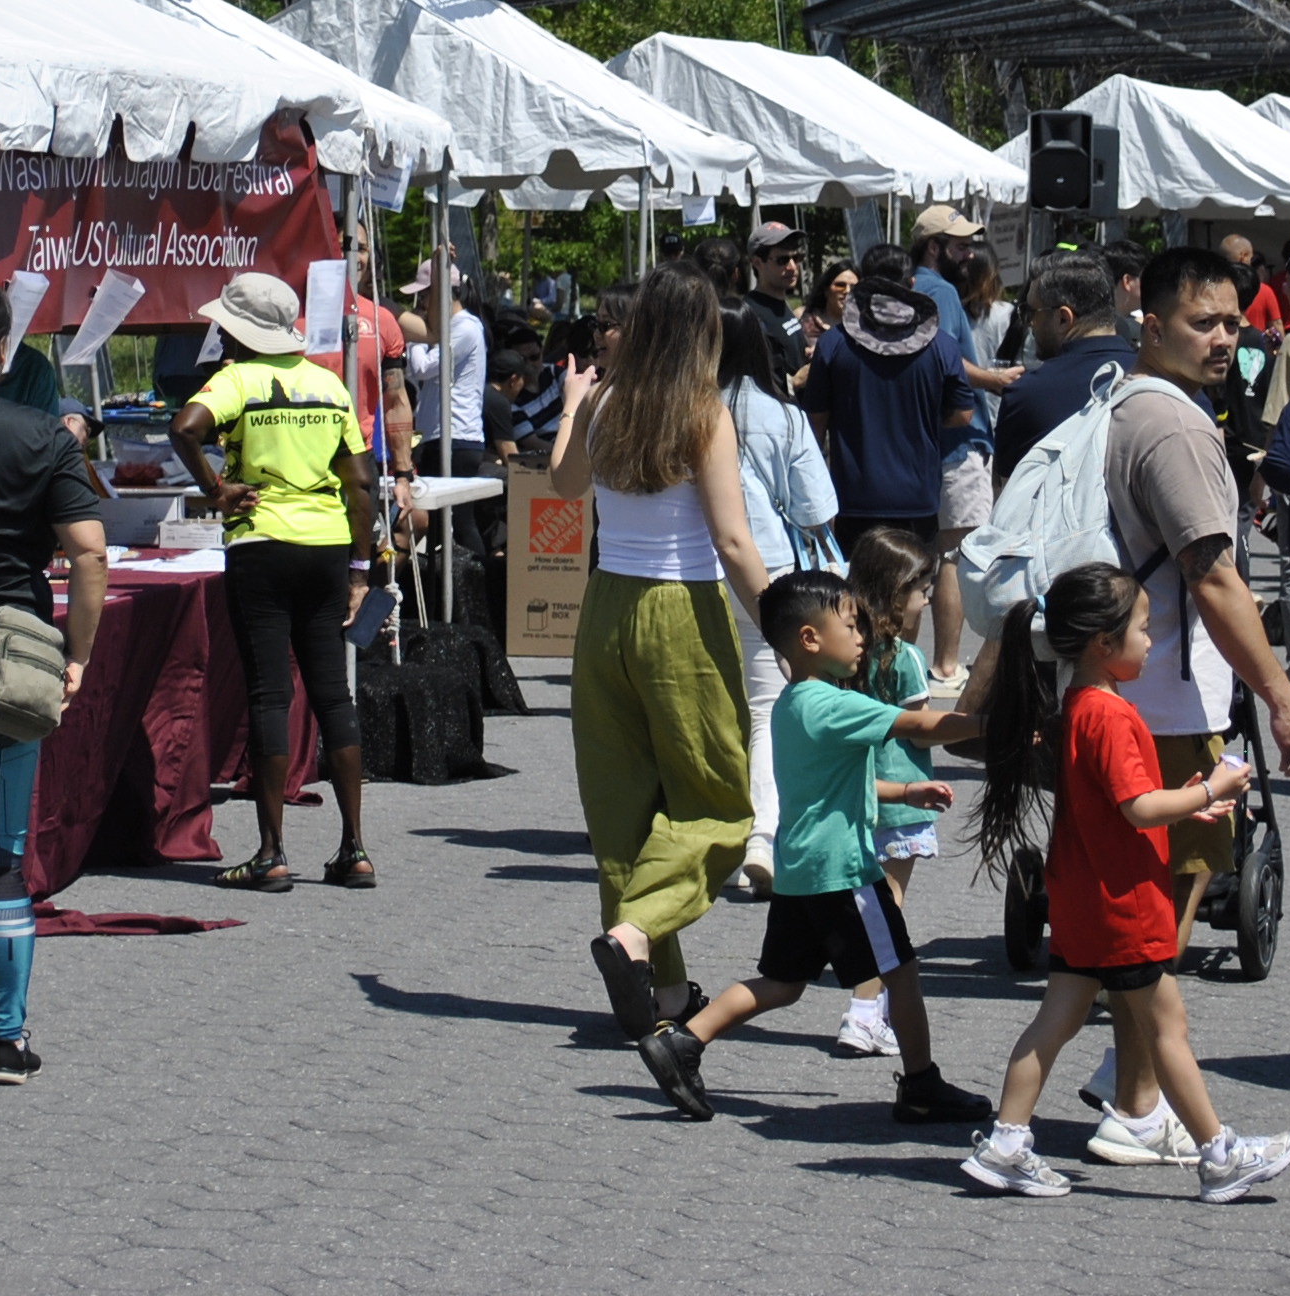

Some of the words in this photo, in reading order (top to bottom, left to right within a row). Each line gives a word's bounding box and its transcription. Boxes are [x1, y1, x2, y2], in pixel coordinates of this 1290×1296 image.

[124, 159, 181, 200] Dragon
[187, 162, 222, 192] Boa
[224, 156, 294, 196] Festival
[105, 220, 162, 267] Cultural
[162, 222, 258, 267] Association
[250, 412, 328, 427] Washington
[530, 501, 583, 552] HOME
[536, 504, 556, 526] THE
[550, 520, 583, 552] DEPOT
[527, 565, 539, 573] get
[551, 603, 580, 611] TRASH
